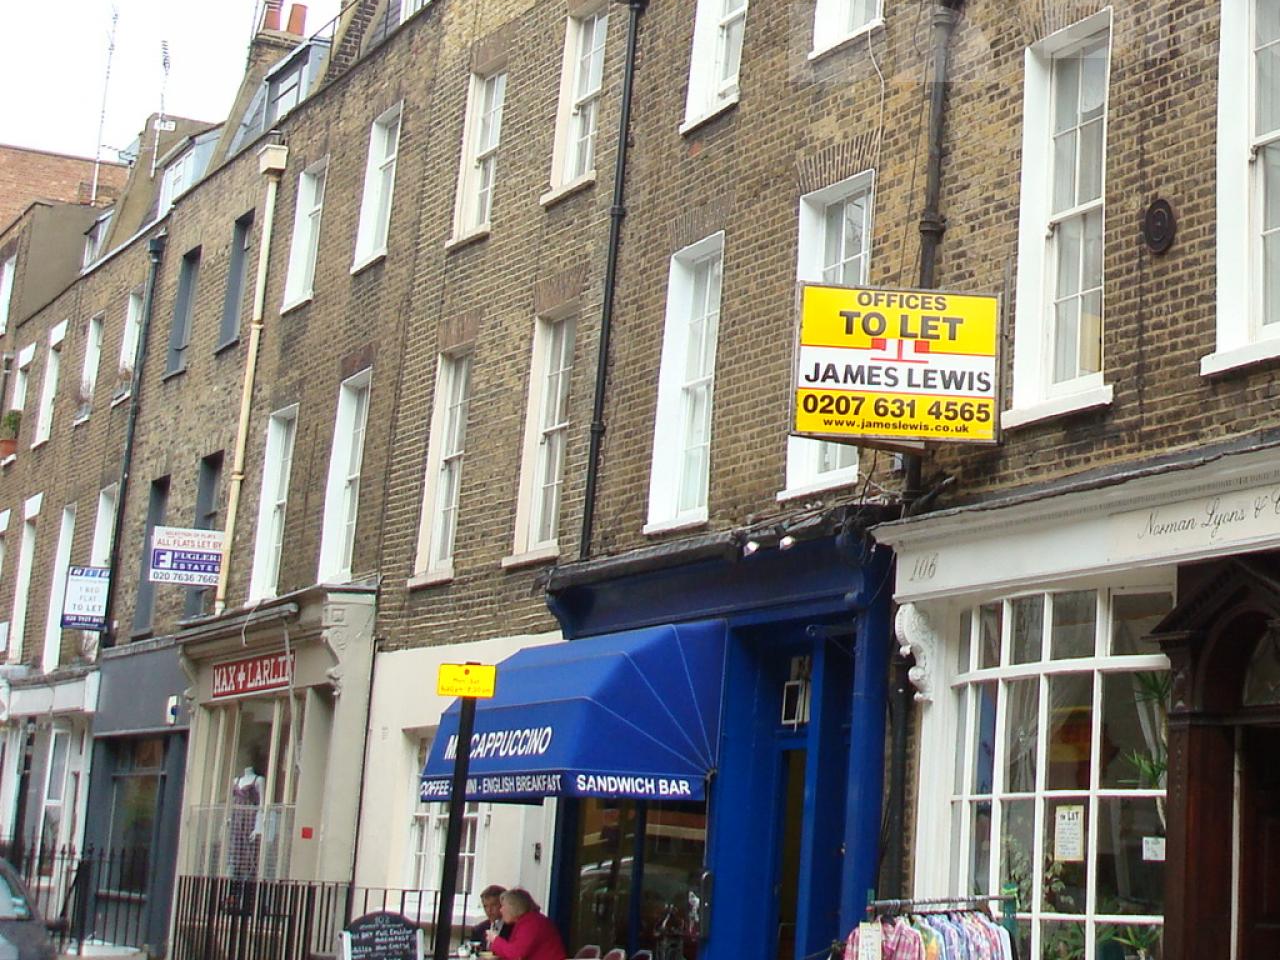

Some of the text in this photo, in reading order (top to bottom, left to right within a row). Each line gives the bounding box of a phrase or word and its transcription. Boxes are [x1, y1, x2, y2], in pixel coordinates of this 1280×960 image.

[857, 292, 947, 311] OFFICES
[839, 311, 964, 341] TO LET
[804, 362, 992, 392] JAMES LEWIS
[803, 394, 990, 422] 0207 631 4565
[823, 418, 969, 433] www.jameslewis.co.uk
[1137, 510, 1197, 539] Norman
[1200, 497, 1247, 539] Lyons
[1254, 496, 1268, 519] &
[153, 571, 170, 580] 020
[214, 665, 236, 692] MAX
[469, 726, 553, 759] CAPPUCCINO
[420, 780, 450, 797] COFFEE
[482, 775, 514, 794] ENGLISH
[516, 774, 562, 792] BREAKFAST
[576, 774, 691, 796] SANDWICH BAR
